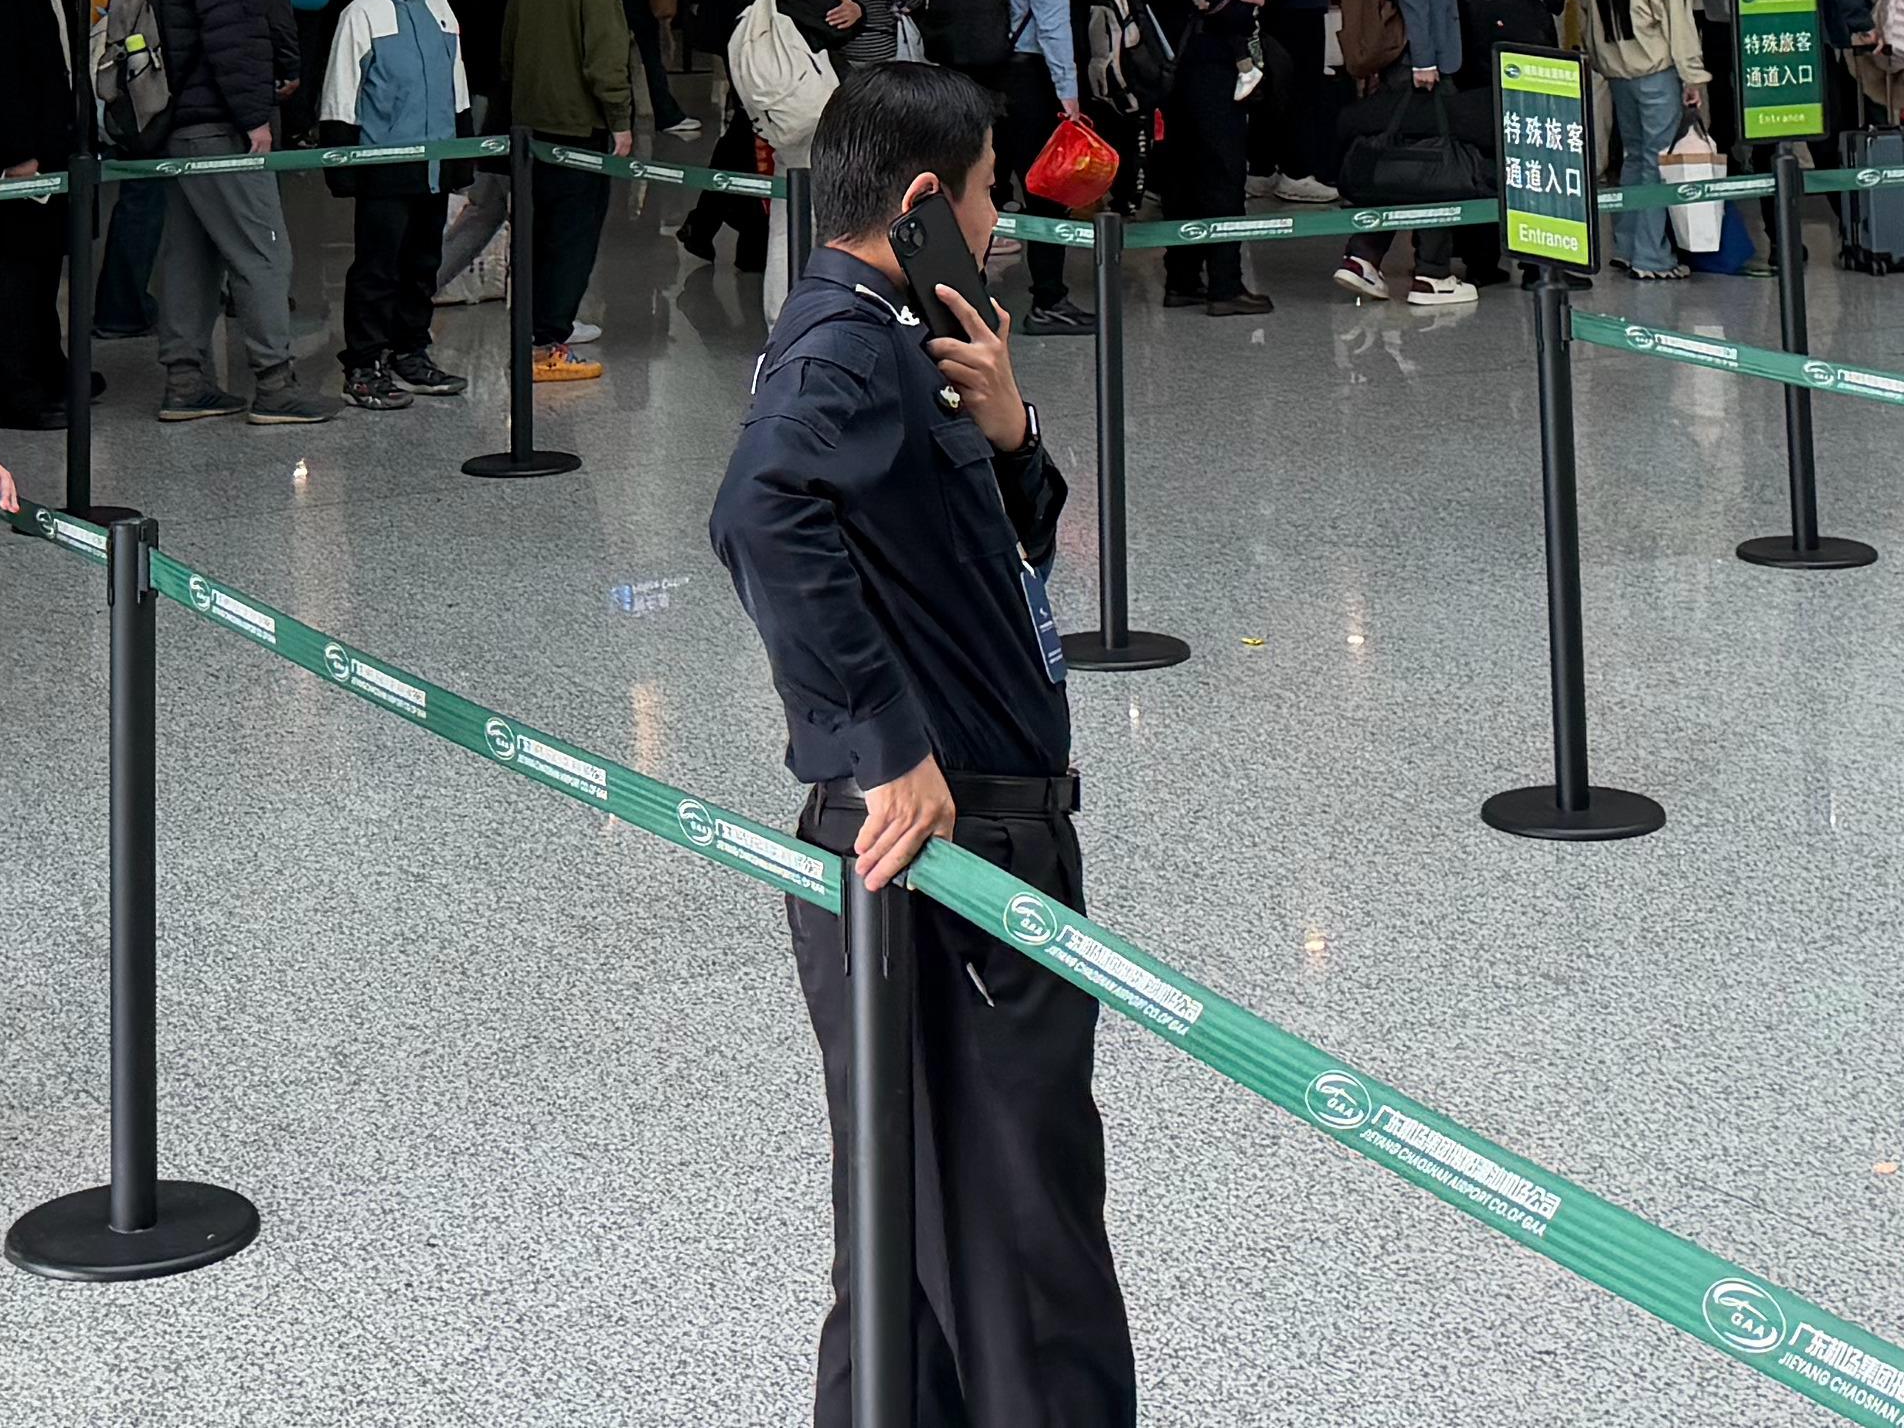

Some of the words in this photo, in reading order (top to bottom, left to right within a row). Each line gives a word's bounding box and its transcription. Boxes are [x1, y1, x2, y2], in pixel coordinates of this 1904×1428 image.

[1744, 31, 1812, 56] 特殊旅客
[1746, 64, 1813, 88] 通道入口
[1503, 110, 1584, 155] 特殊旅客
[1758, 112, 1806, 125] Entrance
[1505, 155, 1582, 198] 通道入口
[1518, 222, 1579, 252] Entrance
[1729, 1312, 1766, 1340] GAA
[1778, 1352, 1831, 1387] JIEYANG
[1829, 1375, 1899, 1423] CHAOSHAN
